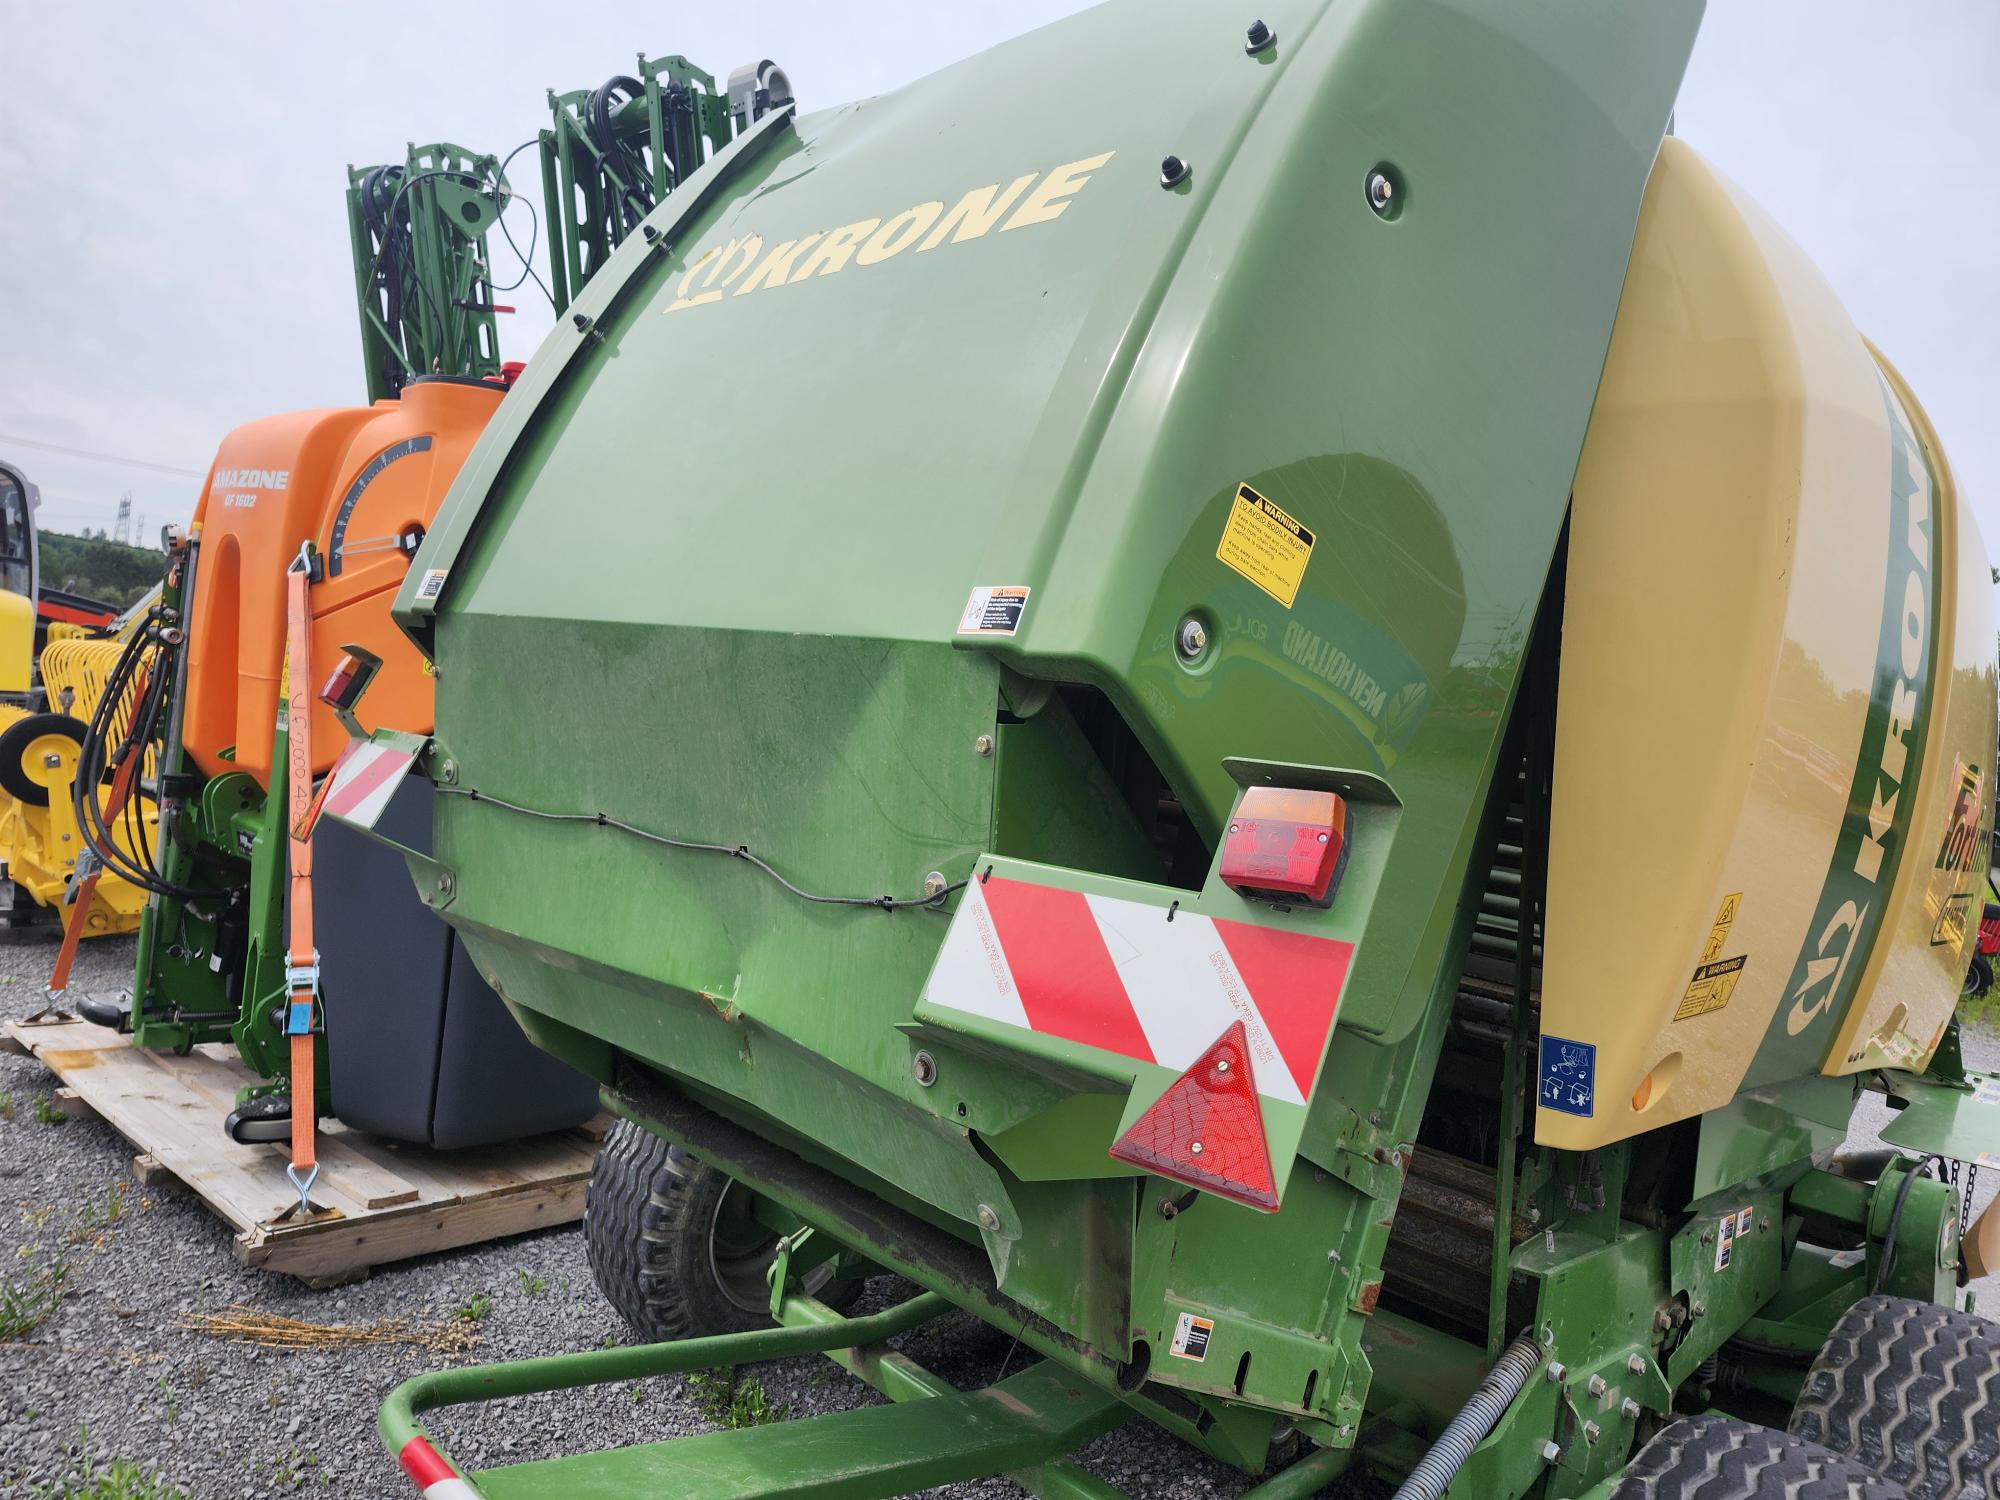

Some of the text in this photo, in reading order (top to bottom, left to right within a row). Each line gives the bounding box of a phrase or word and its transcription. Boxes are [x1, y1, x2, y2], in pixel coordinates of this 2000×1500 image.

[733, 150, 1116, 297] KRONE
[1238, 500, 1307, 555] TO AVOID BODILY INJURY
[1262, 501, 1301, 535] WARNING
[1854, 385, 1929, 884] KRON
[1708, 958, 1742, 976] WARNING
